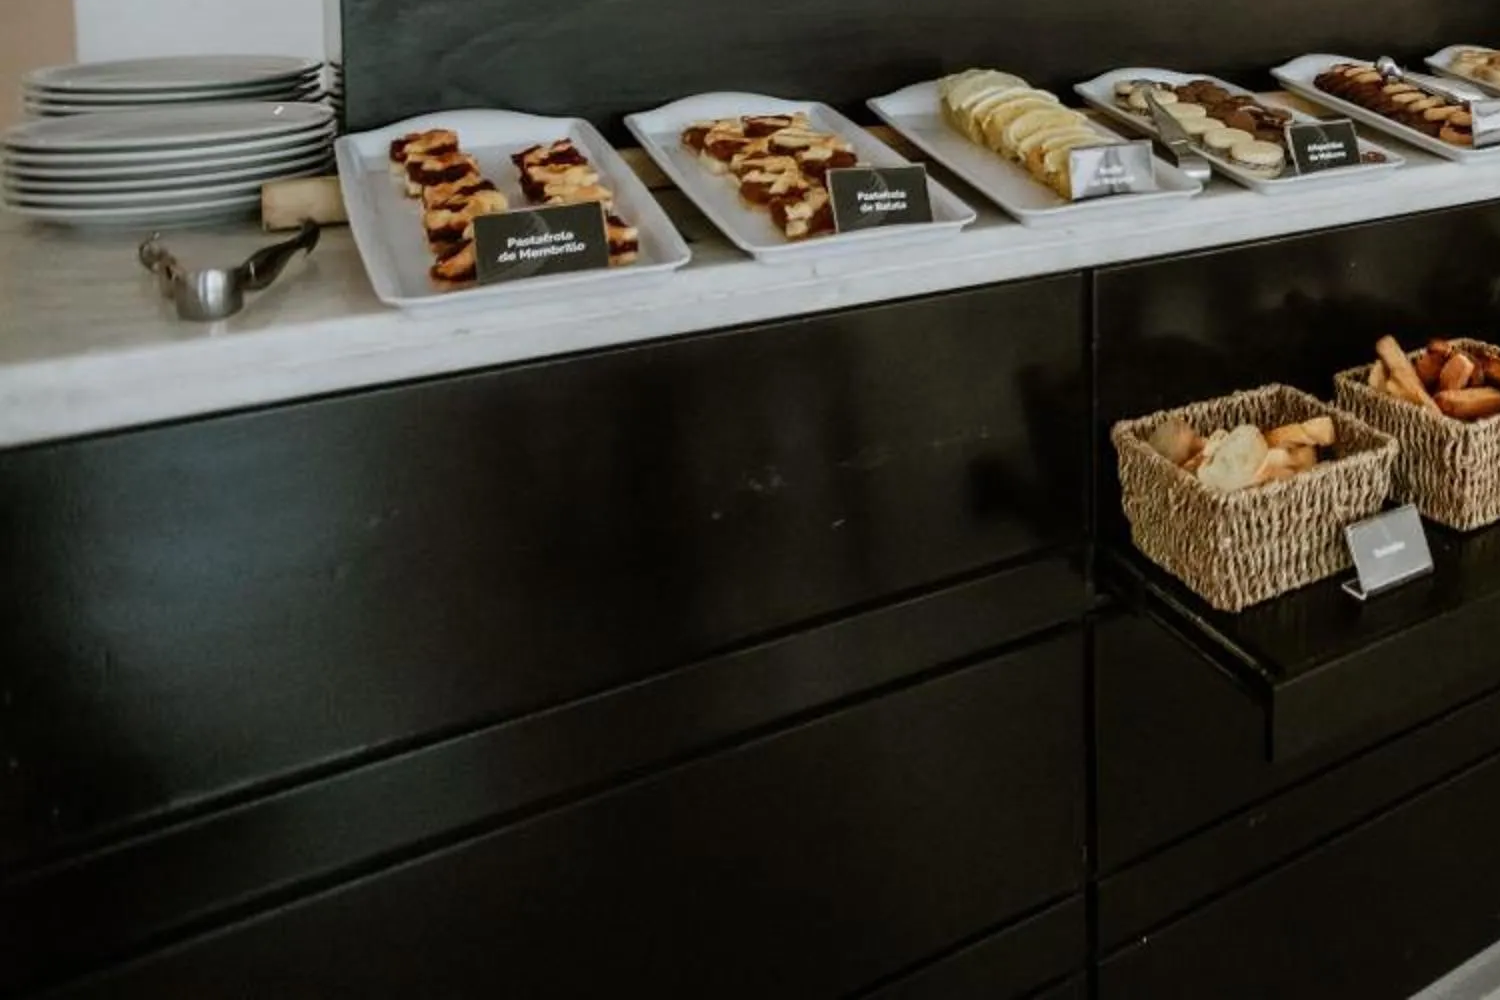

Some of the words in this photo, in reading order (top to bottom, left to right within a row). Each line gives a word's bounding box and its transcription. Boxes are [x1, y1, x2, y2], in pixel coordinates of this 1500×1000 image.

[857, 190, 907, 201] Pastafrola
[860, 203, 873, 214] de
[507, 231, 574, 249] Pastafrola
[497, 251, 517, 263] de
[519, 242, 586, 260] Membrillo
